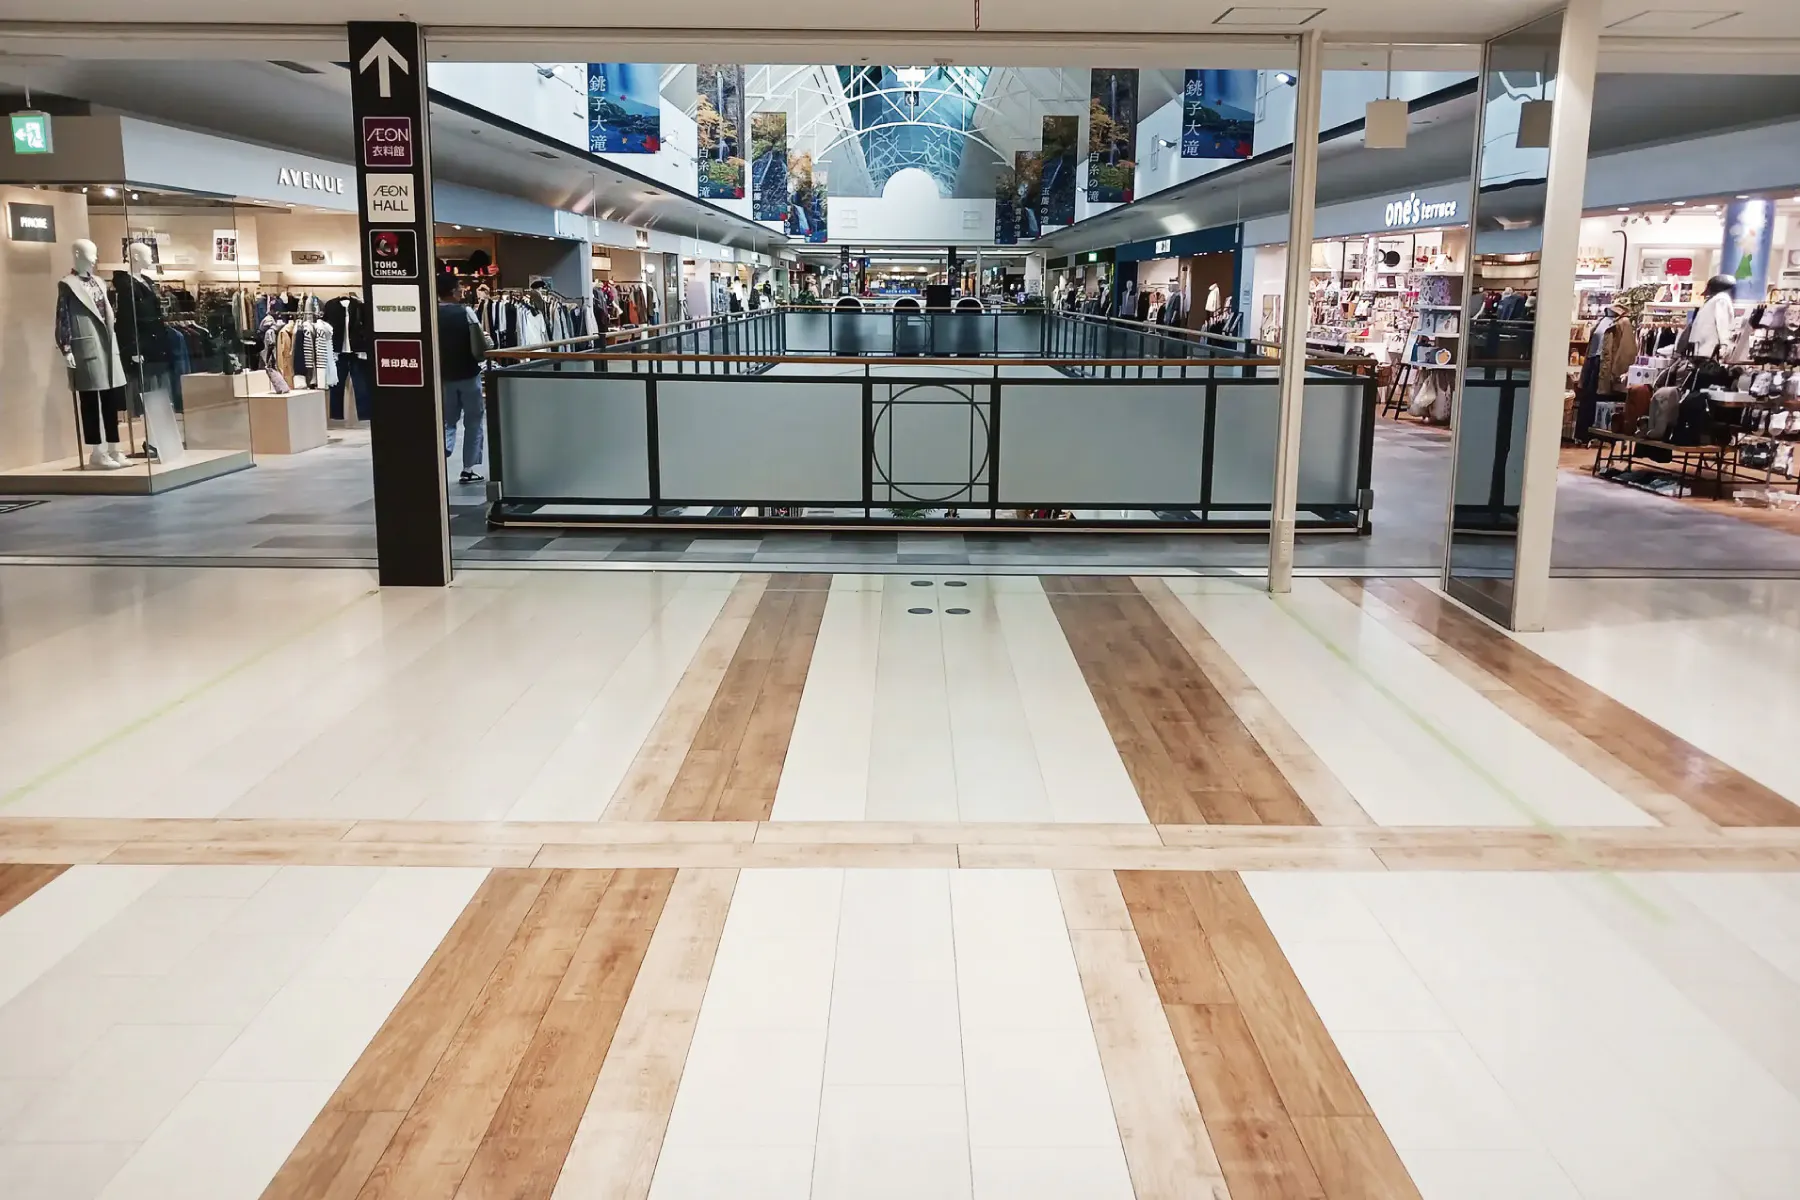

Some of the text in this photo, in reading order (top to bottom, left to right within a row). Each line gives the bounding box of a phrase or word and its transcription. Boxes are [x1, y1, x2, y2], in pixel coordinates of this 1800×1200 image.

[589, 75, 607, 151] 銚子大滝
[1182, 79, 1203, 156] 銚子大滝
[372, 145, 405, 157] 衣料館
[277, 167, 344, 194] AVENUE
[699, 147, 711, 197] 白糸の滝
[1088, 151, 1100, 202] 白糸の滝
[373, 199, 409, 212] HALL
[1385, 192, 1457, 227] one's terrace
[374, 261, 398, 269] TOHO
[381, 358, 418, 368] 無印良品
